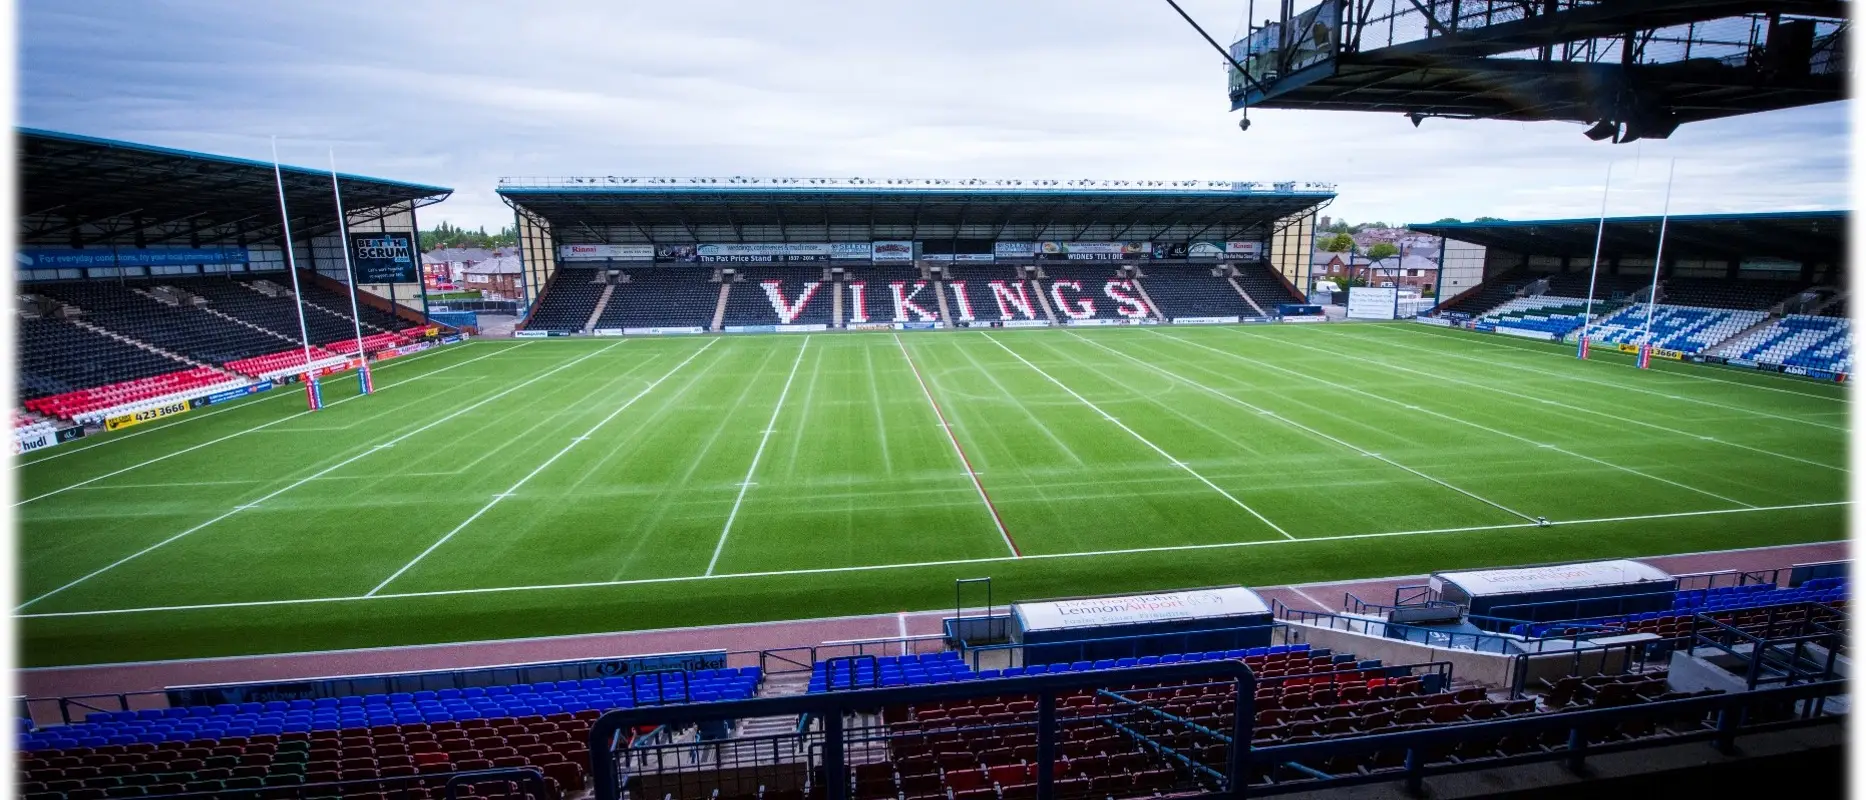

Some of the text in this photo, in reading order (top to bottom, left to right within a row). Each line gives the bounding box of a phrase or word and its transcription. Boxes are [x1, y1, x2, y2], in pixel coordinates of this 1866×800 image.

[359, 247, 410, 259] SCRUM
[571, 245, 597, 253] Rinnai
[38, 254, 54, 263] For
[57, 254, 93, 264] everyday
[94, 252, 138, 263] condtions,
[760, 279, 1151, 323] VIKINGS
[135, 402, 185, 422] 423 3666
[22, 436, 47, 451] hudl
